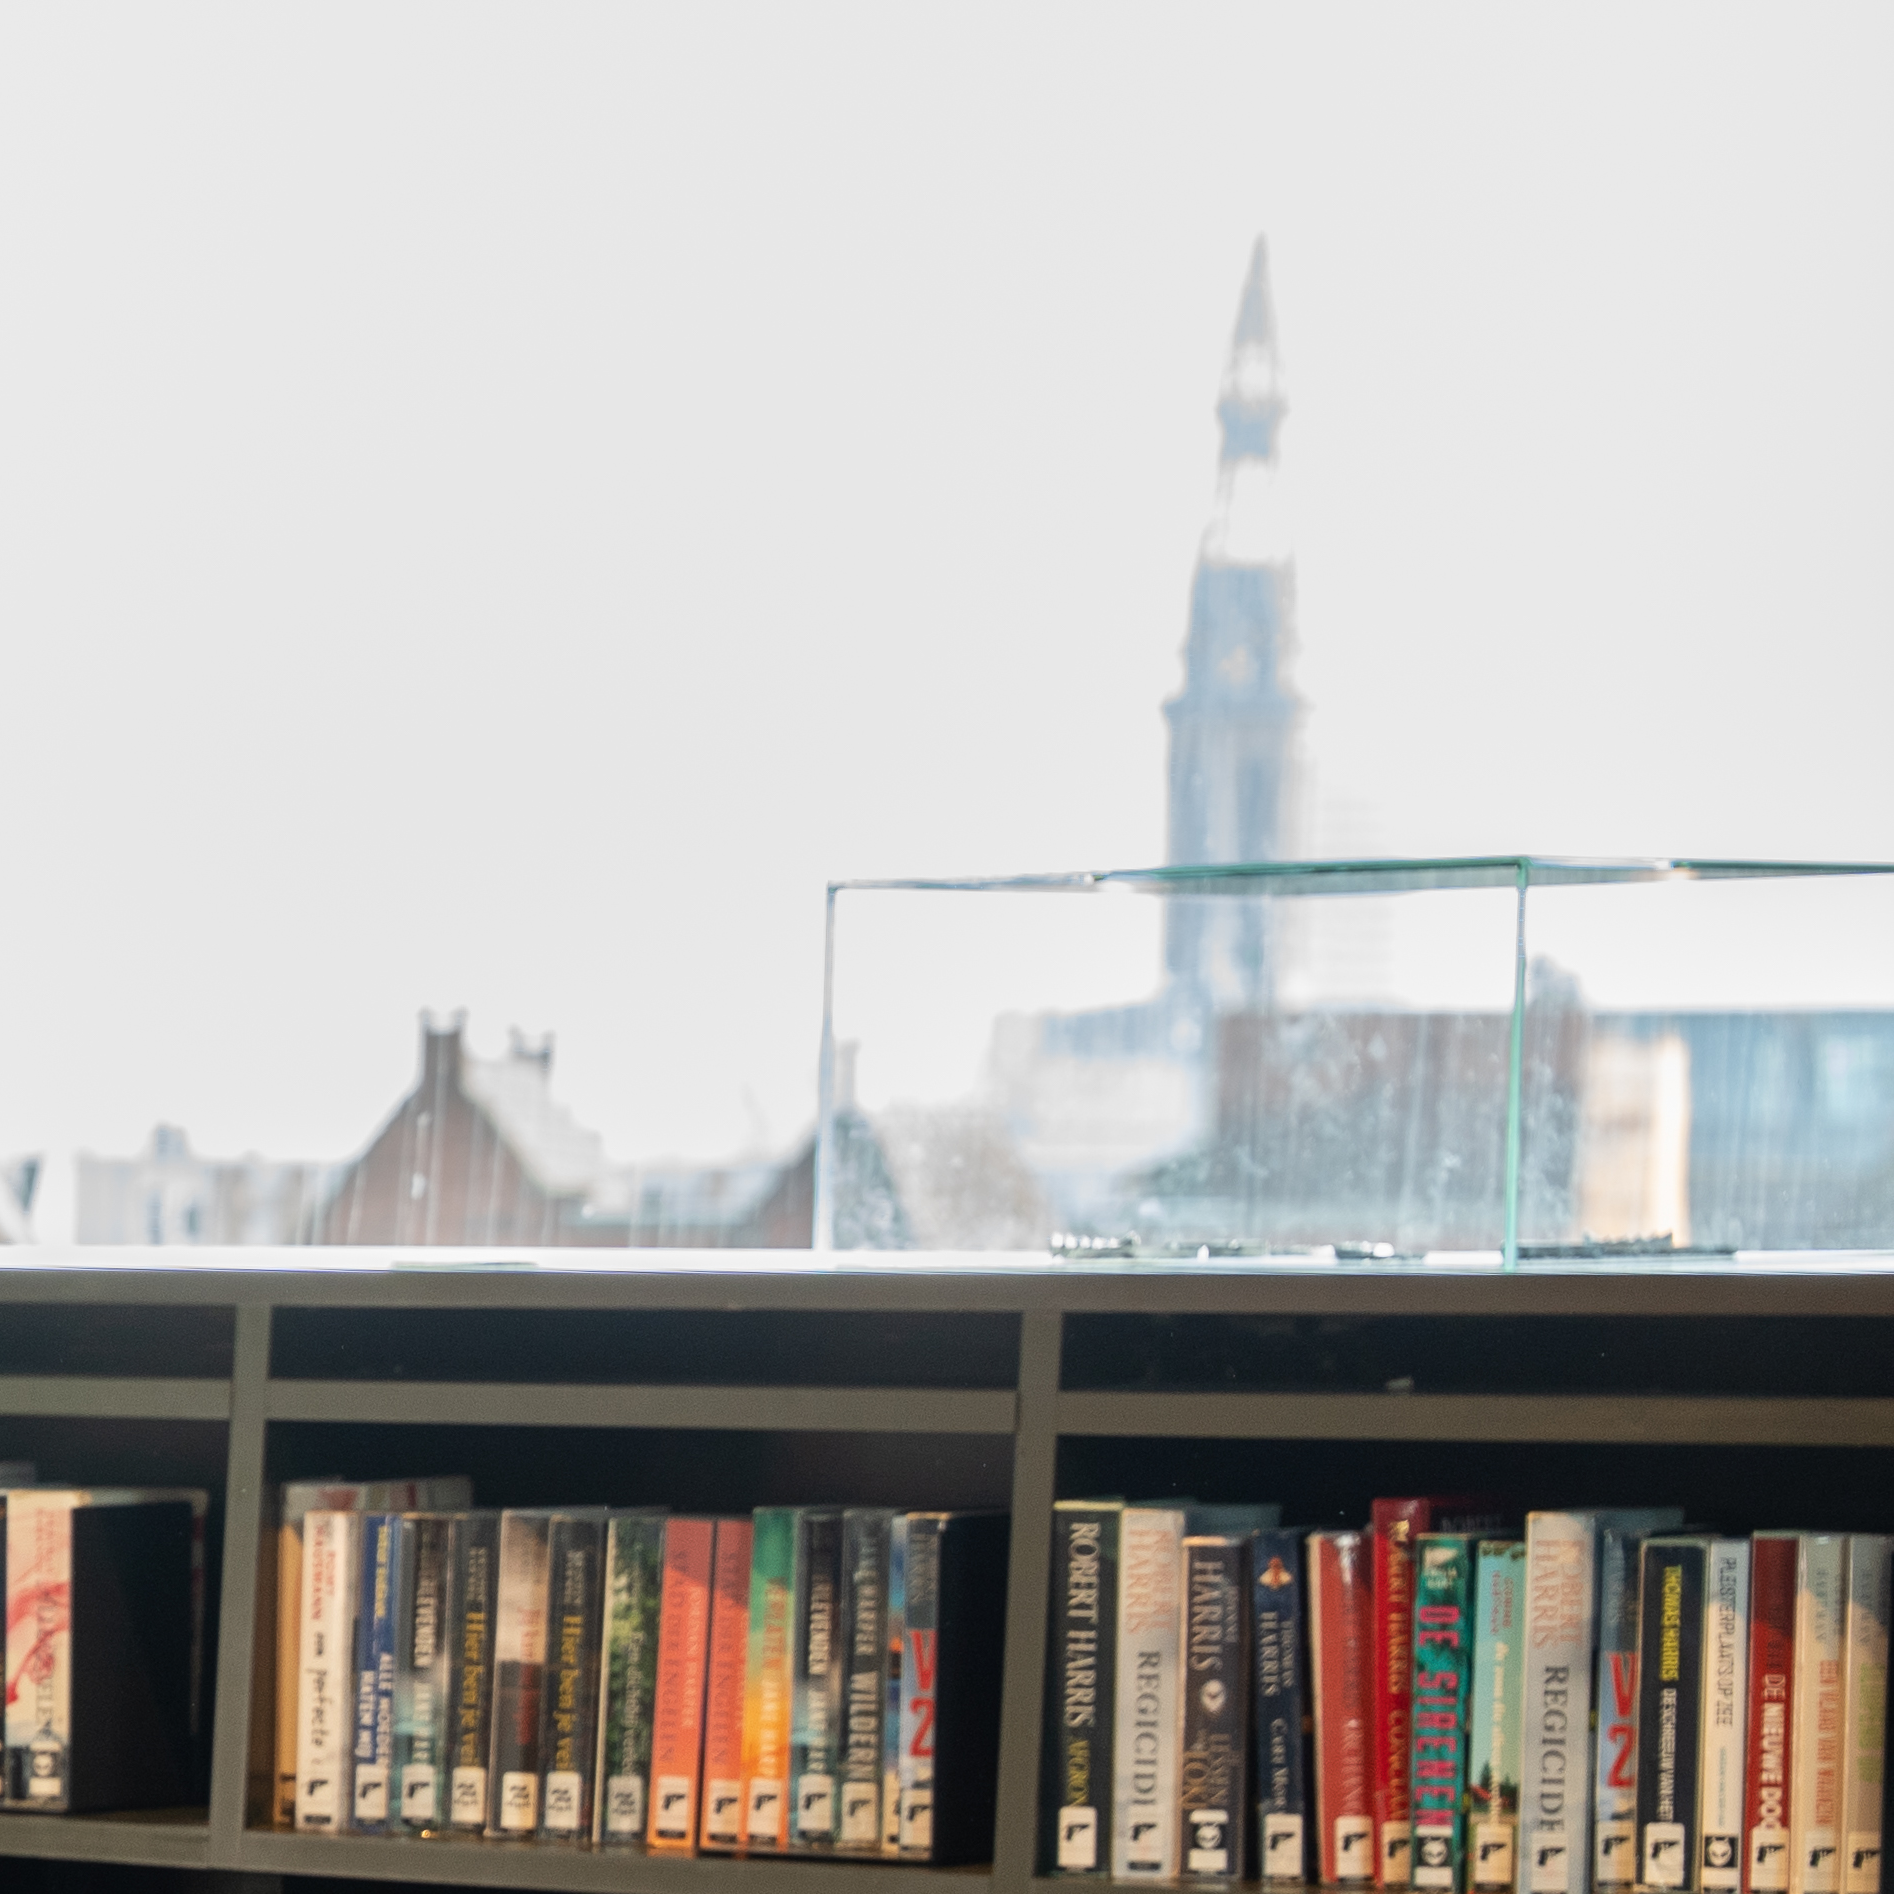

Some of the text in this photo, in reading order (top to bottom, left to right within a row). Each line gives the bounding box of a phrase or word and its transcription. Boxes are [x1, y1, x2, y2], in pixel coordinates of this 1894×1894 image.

[1127, 1529, 1155, 1634] HARRIS
[1532, 1539, 1561, 1650] HARRIS
[1662, 1565, 1682, 1627] THOMAS
[464, 1612, 486, 1662] Hier
[561, 1615, 584, 1663] Hier
[1190, 1560, 1224, 1671] HARRIS
[1418, 1604, 1460, 1649] DE
[1718, 1557, 1738, 1675] PLEISTERPLAATS
[461, 1665, 485, 1704] ben
[1064, 1522, 1101, 1807] ROBERT HARRIS AFGRON
[1258, 1611, 1281, 1697] HARRIS
[1661, 1627, 1680, 1682] HARRIS
[558, 1668, 581, 1708] ben
[1715, 1700, 1733, 1728] ZEE
[1717, 1678, 1734, 1698] OP
[376, 1697, 392, 1765] MOEDER
[849, 1670, 879, 1781] WILDERN
[1538, 1665, 1570, 1833] REGICIDE
[1759, 1672, 1786, 1830] DE NIEUWE DOO
[1658, 1771, 1675, 1793] VAN
